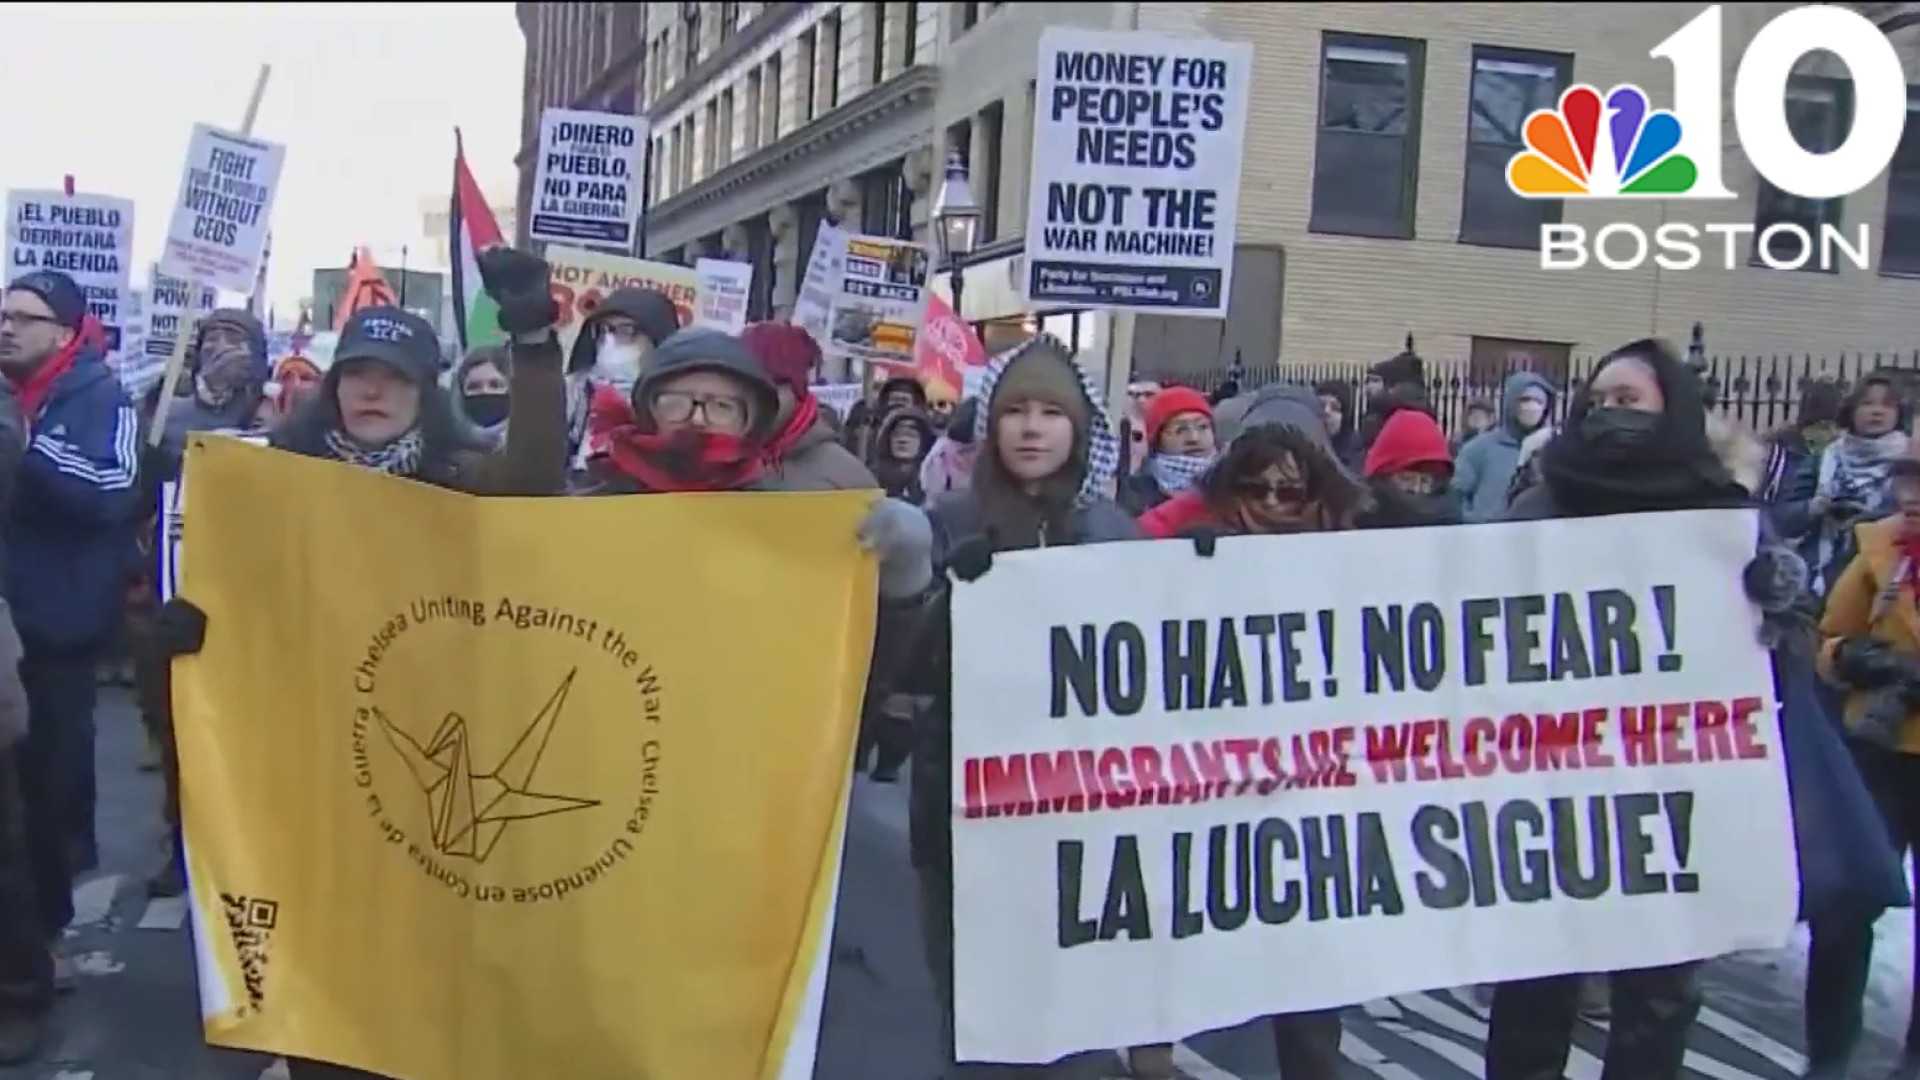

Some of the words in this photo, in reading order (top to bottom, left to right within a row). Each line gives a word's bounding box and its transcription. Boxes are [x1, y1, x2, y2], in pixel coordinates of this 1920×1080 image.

[1055, 51, 1165, 85] MONEY
[1172, 58, 1226, 90] FOR
[1052, 87, 1223, 131] PEOPLE'S
[552, 123, 634, 147] ¡DINERO
[1076, 128, 1195, 168] NEEDS
[208, 147, 257, 180] FIGHT
[547, 153, 631, 180] PUEBLO,
[185, 183, 262, 227] WITHOUT
[544, 177, 570, 197] NO
[577, 181, 626, 203] PARA
[1047, 183, 1132, 225] NOT
[1142, 188, 1216, 229] THE
[18, 203, 44, 223] ¡EL
[51, 205, 120, 227] PUEBLO
[541, 197, 558, 212] LA
[563, 200, 626, 218] GUERRA!
[193, 214, 238, 247] CEOS
[1044, 228, 1096, 251] WAR
[1105, 230, 1214, 257] MACHINE!
[14, 247, 37, 266] LA
[43, 250, 119, 273] AGENDA
[153, 288, 213, 309] POWR
[356, 614, 408, 693] Chelsea
[411, 596, 486, 626] Uniting
[494, 597, 599, 642] Against
[602, 629, 639, 668] the
[637, 664, 661, 723] War
[1049, 621, 1147, 718] NO
[1161, 609, 1338, 712] HATE!
[1362, 602, 1445, 693] NO
[1461, 585, 1682, 687] FEAR!
[353, 707, 373, 788] Guerra
[965, 737, 1286, 819] IMMIGRANTS
[1286, 727, 1358, 790] ARE
[1365, 708, 1614, 783] WELCOME
[1620, 697, 1767, 767] HERE
[626, 740, 660, 834] Chelsea
[380, 819, 406, 845] de
[1058, 835, 1152, 948] LA
[1171, 811, 1404, 939] LUCHA
[1410, 792, 1699, 909] SIGUE!
[475, 885, 505, 902] en
